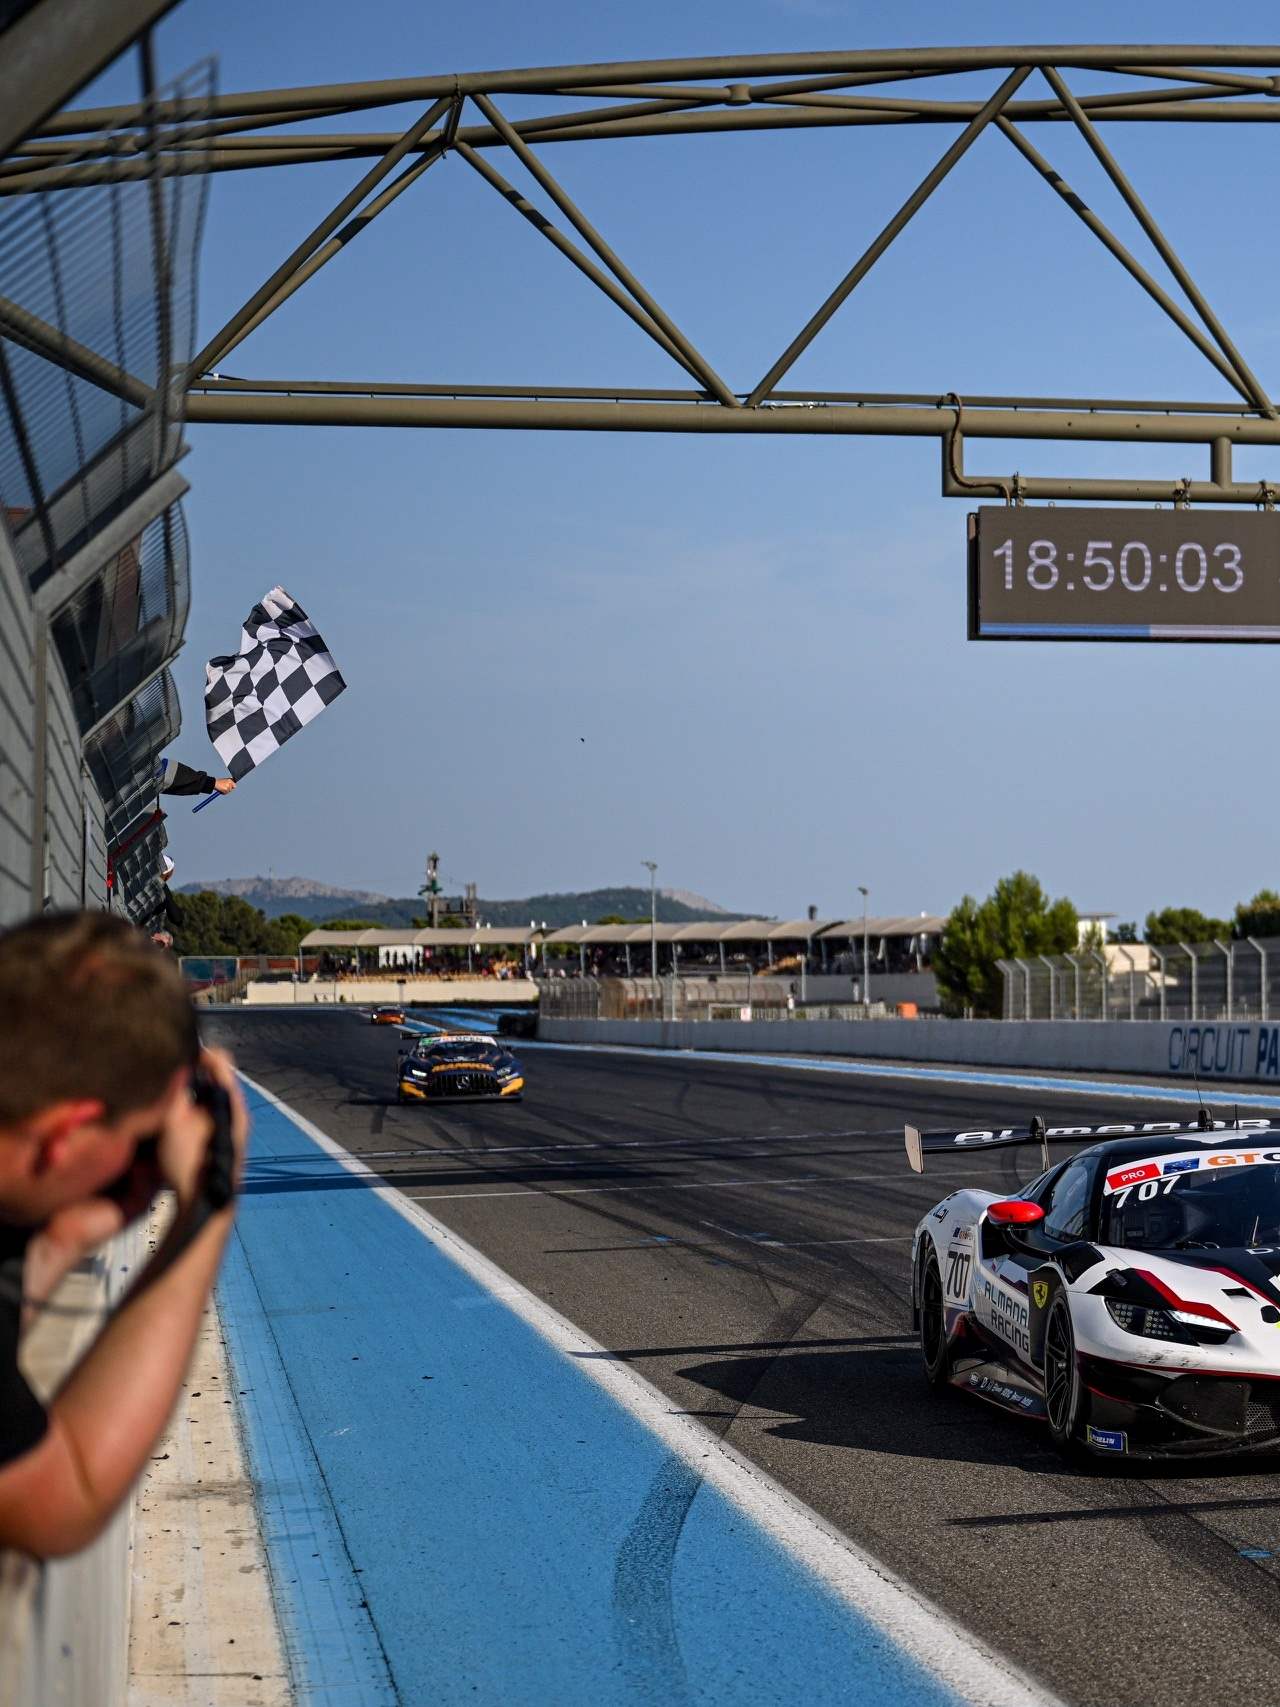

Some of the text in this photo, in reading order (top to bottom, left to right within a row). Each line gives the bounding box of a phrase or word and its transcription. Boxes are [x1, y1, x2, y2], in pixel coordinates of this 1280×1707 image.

[992, 538, 1244, 593] 18:50:03
[1168, 1027, 1250, 1073] CIRCUIT
[1113, 1176, 1179, 1209] 707
[1120, 1169, 1146, 1183] PRO
[946, 1250, 971, 1301] 707
[984, 1280, 1029, 1328] ALMANA
[991, 1309, 1030, 1353] RACING
